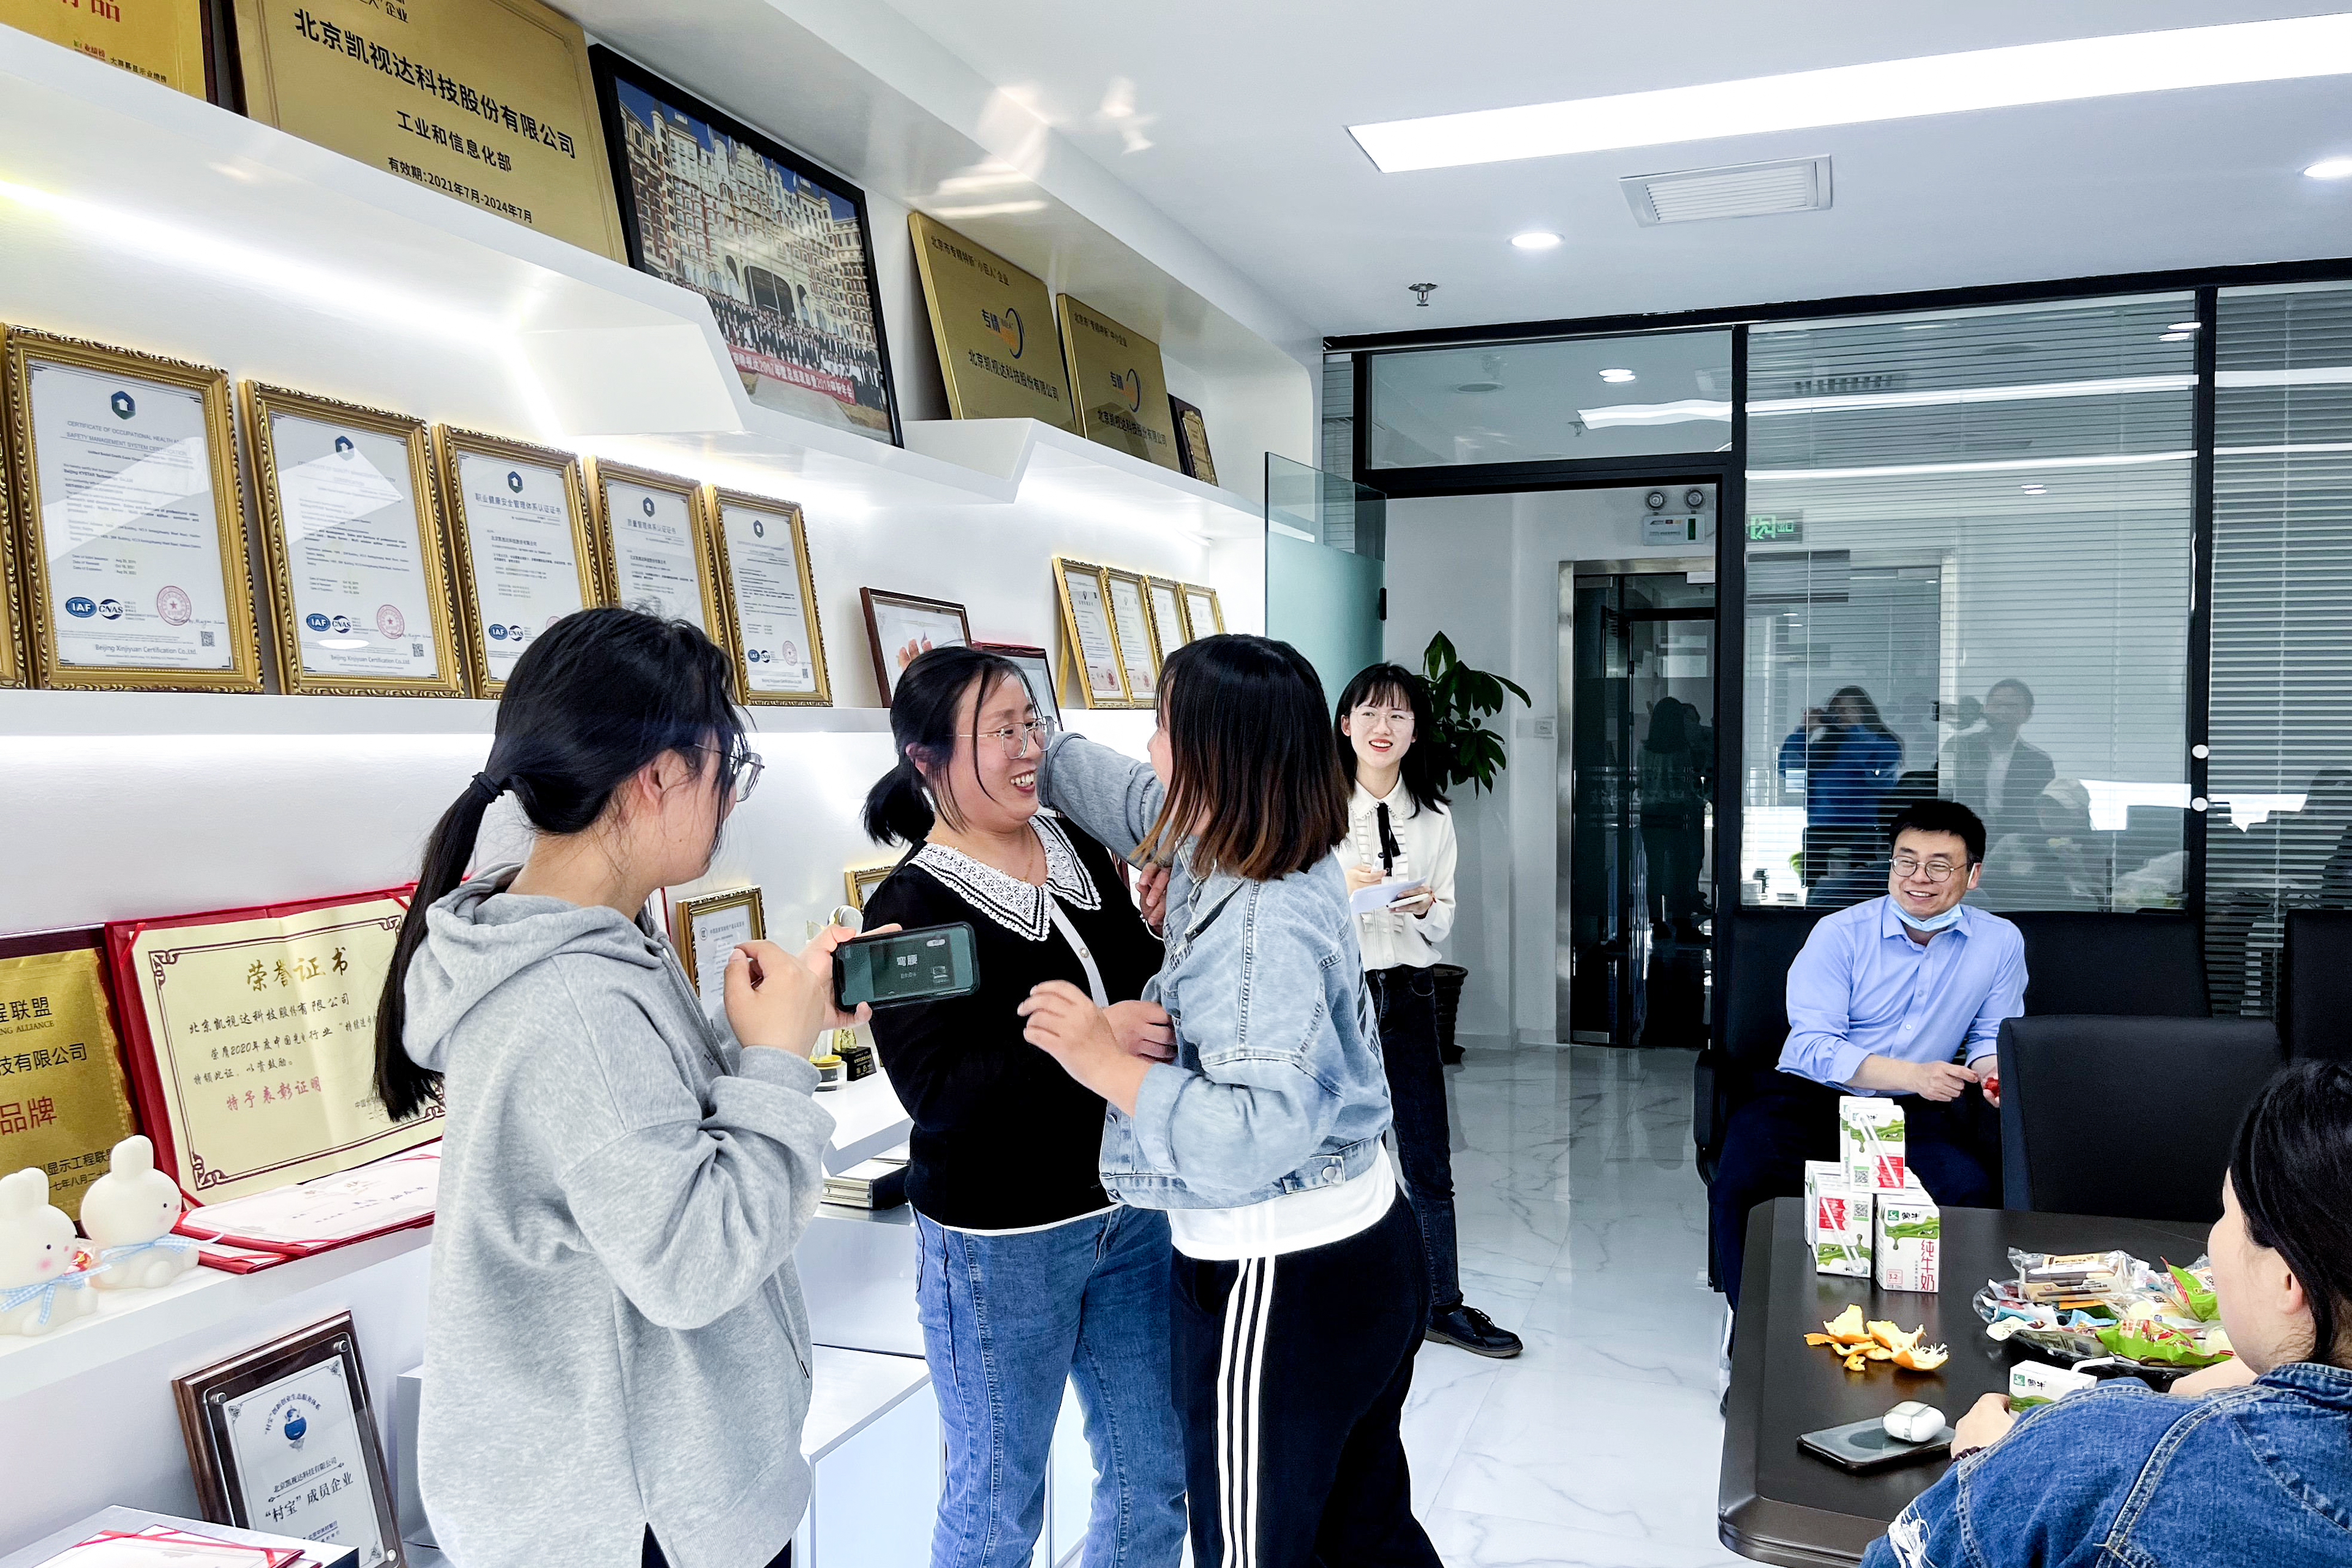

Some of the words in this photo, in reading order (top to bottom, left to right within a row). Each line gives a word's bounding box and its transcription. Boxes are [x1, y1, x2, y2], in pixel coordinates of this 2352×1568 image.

[293, 9, 576, 159] 北京凯视达科技股份有限公司
[397, 110, 512, 173] 工业和信息化部
[968, 349, 1059, 401] 北京凯视达科技股份有限公司
[67, 420, 102, 431] CERTIFICATE
[111, 428, 153, 440] OCCUPATIONAL
[67, 432, 88, 440] SAFETY
[89, 436, 127, 447] MANAGEMENT
[127, 442, 149, 451] SYSTEM
[475, 492, 562, 516] 职业健康安全管理体系认证证书
[72, 603, 91, 612] IAF
[99, 605, 123, 614] CNAS
[311, 618, 326, 627] IAF
[332, 620, 351, 628] CNAS
[96, 644, 115, 653] Beijing
[247, 946, 349, 991] 荣誉证书
[16, 1020, 55, 1033] ALLIANCE
[189, 993, 350, 1035] 北京凯视达科技股份有限公司
[0, 1096, 57, 1136] 品牌
[1921, 1239, 1934, 1291] 纯牛奶
[274, 1457, 337, 1493] 北京凯视达科技有限公司
[265, 1472, 353, 1522] “村宝”成员企业
